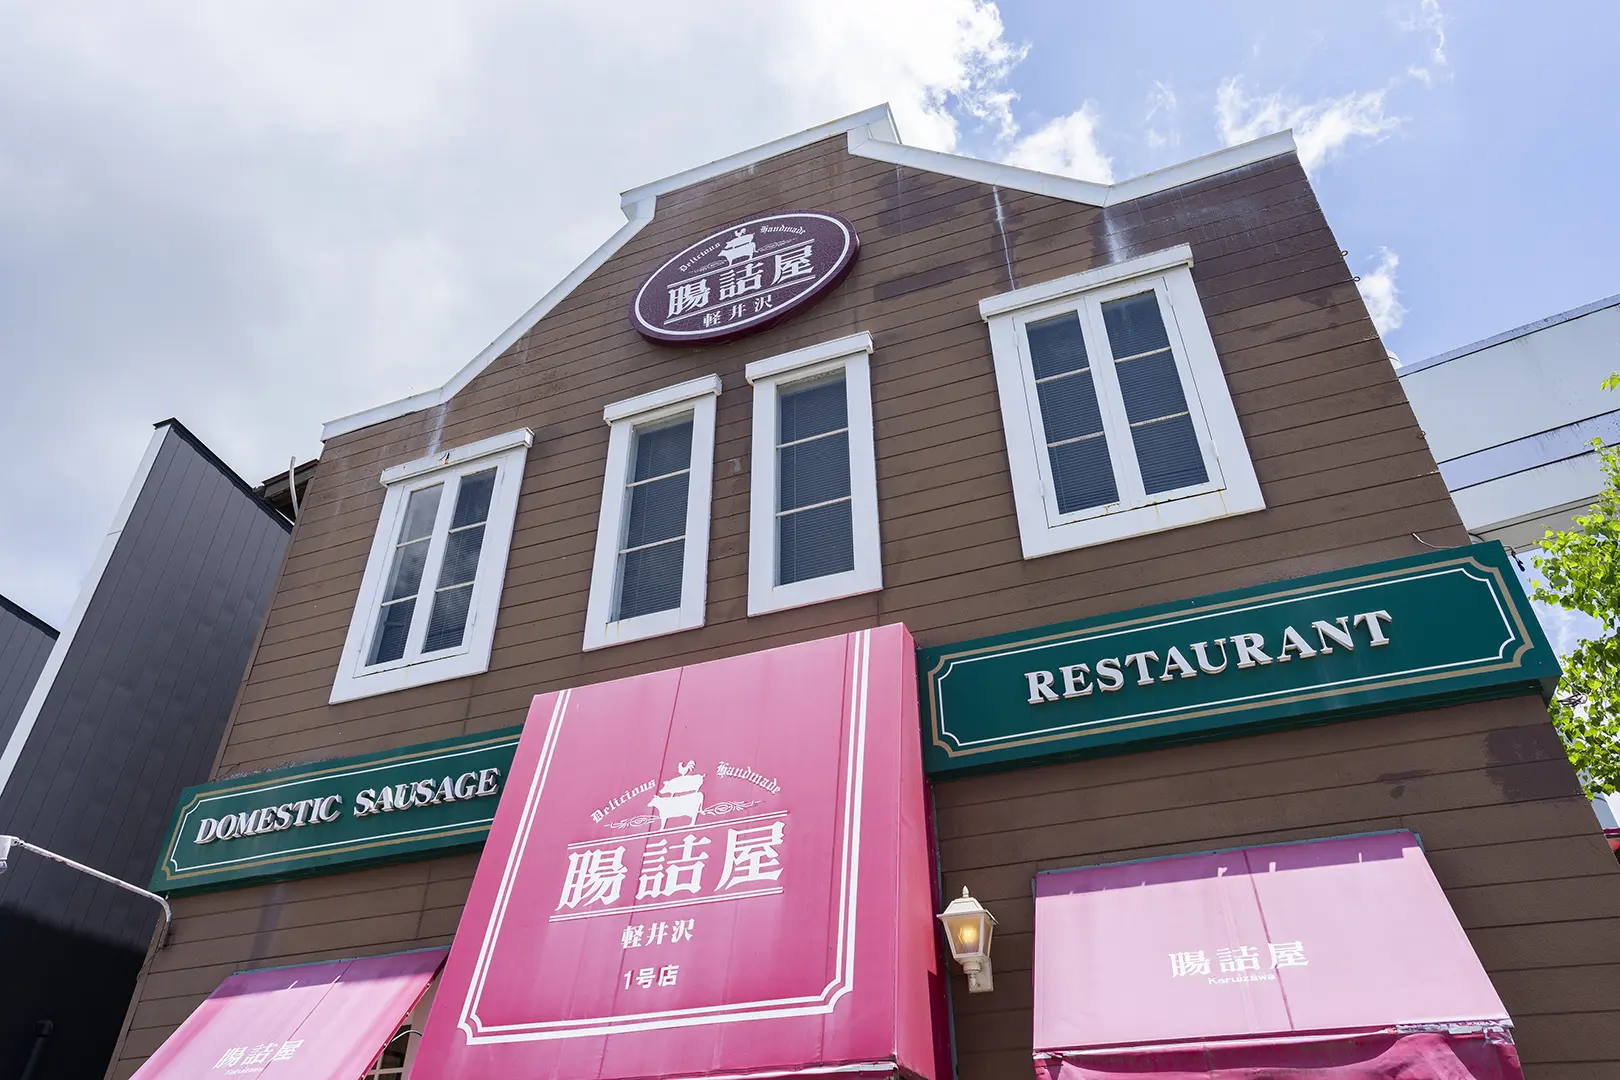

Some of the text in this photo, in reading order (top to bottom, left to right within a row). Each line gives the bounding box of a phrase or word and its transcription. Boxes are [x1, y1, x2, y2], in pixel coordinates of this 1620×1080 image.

[760, 224, 806, 235] Handmade
[667, 244, 815, 319] 腸詰屋
[703, 295, 773, 328] 軽井沢
[1023, 609, 1393, 705] RESTAURANT
[716, 761, 781, 795] Handmade
[194, 767, 501, 845] DOMESTIC SAUSAGE
[590, 779, 657, 824] Delicious
[555, 821, 786, 912] 腸詰屋
[620, 918, 695, 950] 軽井沢
[1168, 940, 1310, 978] 腸詰屋
[623, 965, 680, 990] 1号店
[1208, 973, 1277, 985] Karuizawa
[212, 1039, 305, 1069] 腸詰屋
